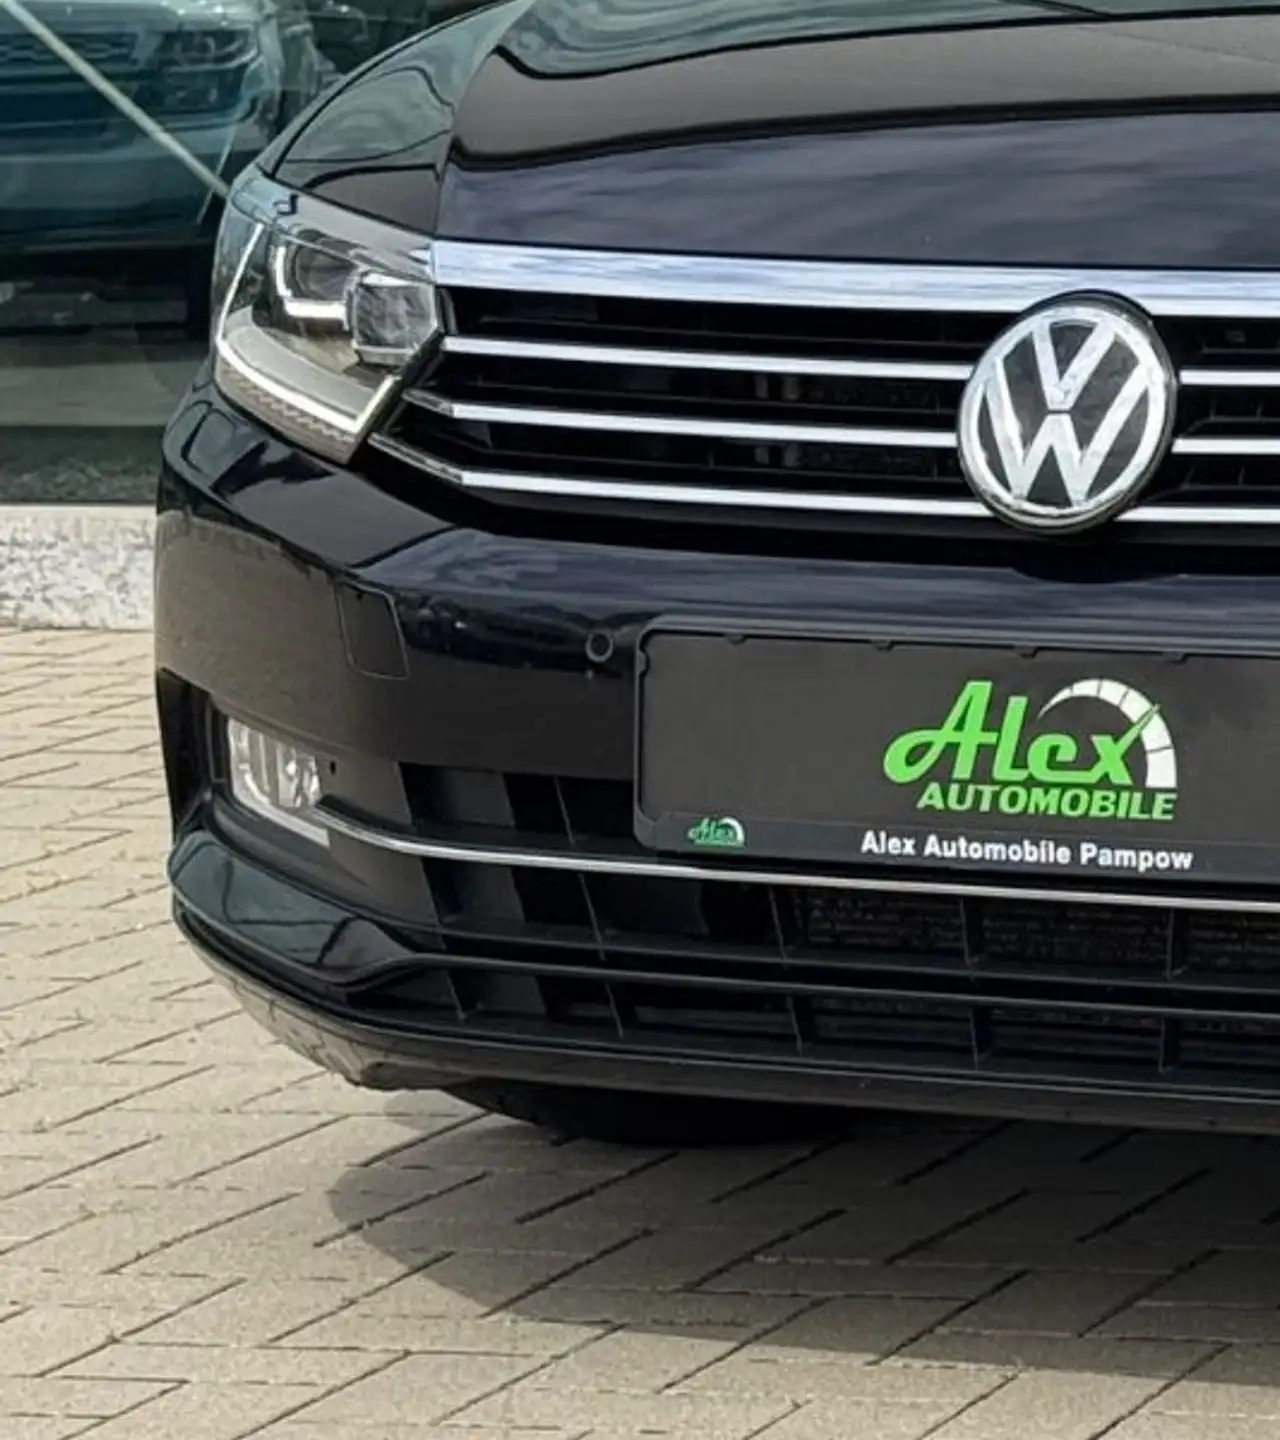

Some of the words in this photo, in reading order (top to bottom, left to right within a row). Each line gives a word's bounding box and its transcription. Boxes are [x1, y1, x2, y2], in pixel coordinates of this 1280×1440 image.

[883, 680, 1148, 785] Alex
[916, 782, 1179, 821] AUTOMOBILE
[859, 830, 916, 857] Alex
[923, 833, 1072, 866] Automobile
[1079, 842, 1194, 872] Pampow
